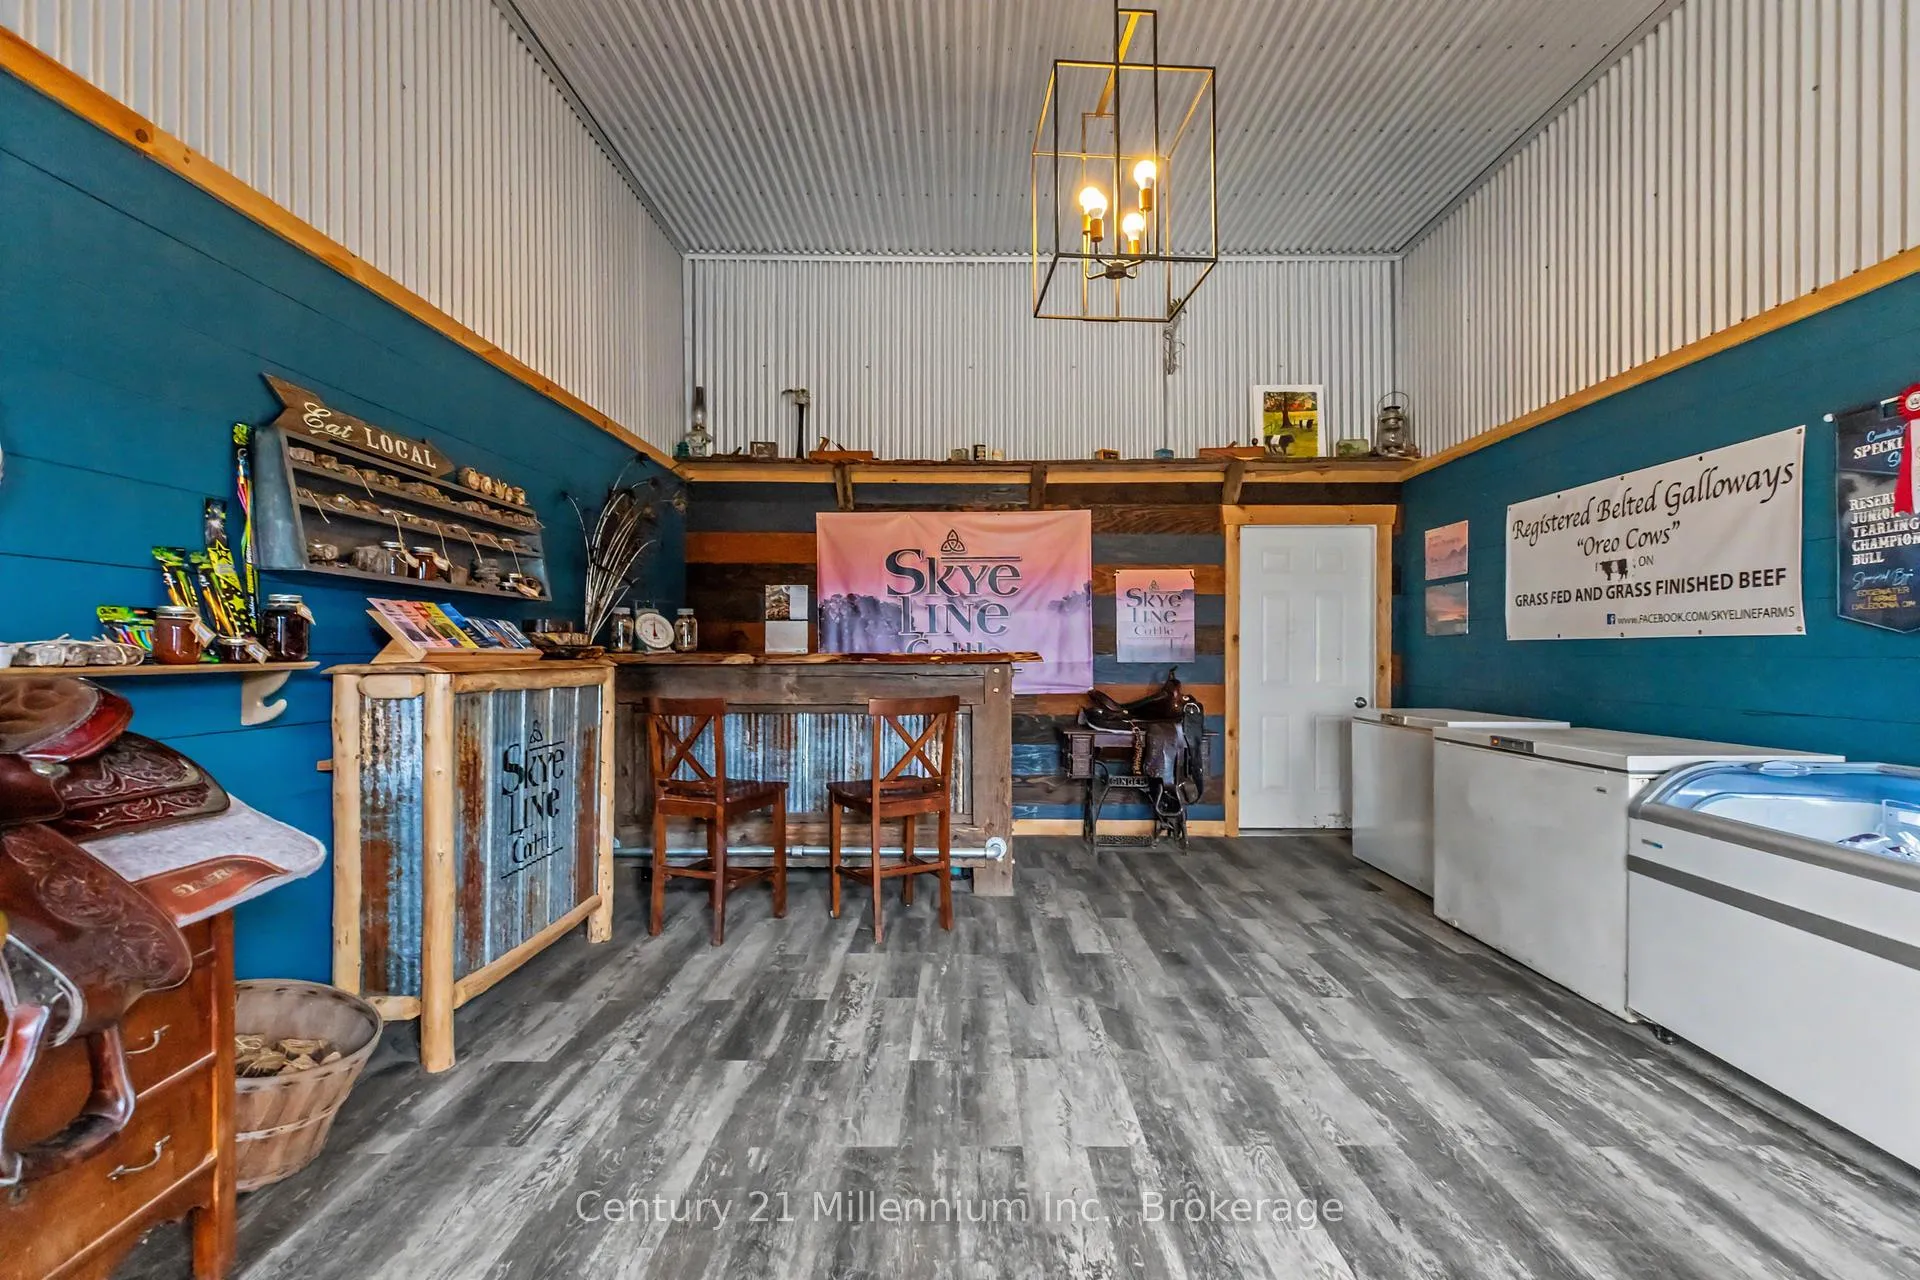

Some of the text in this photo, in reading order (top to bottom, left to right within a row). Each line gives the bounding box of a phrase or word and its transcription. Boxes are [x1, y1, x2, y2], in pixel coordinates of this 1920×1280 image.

[303, 402, 437, 469] Eat LOCAL
[1853, 437, 1904, 460] SPECKL
[1512, 462, 1795, 547] Registered Belted Galloways
[1851, 517, 1920, 538] YEARLING
[886, 549, 1021, 597] Skye
[1852, 552, 1885, 566] BULL
[1126, 587, 1182, 608] Skye
[1515, 567, 1788, 607] GRASS FED AND GRASS FINISHED BEEF
[502, 743, 565, 796] Skye
